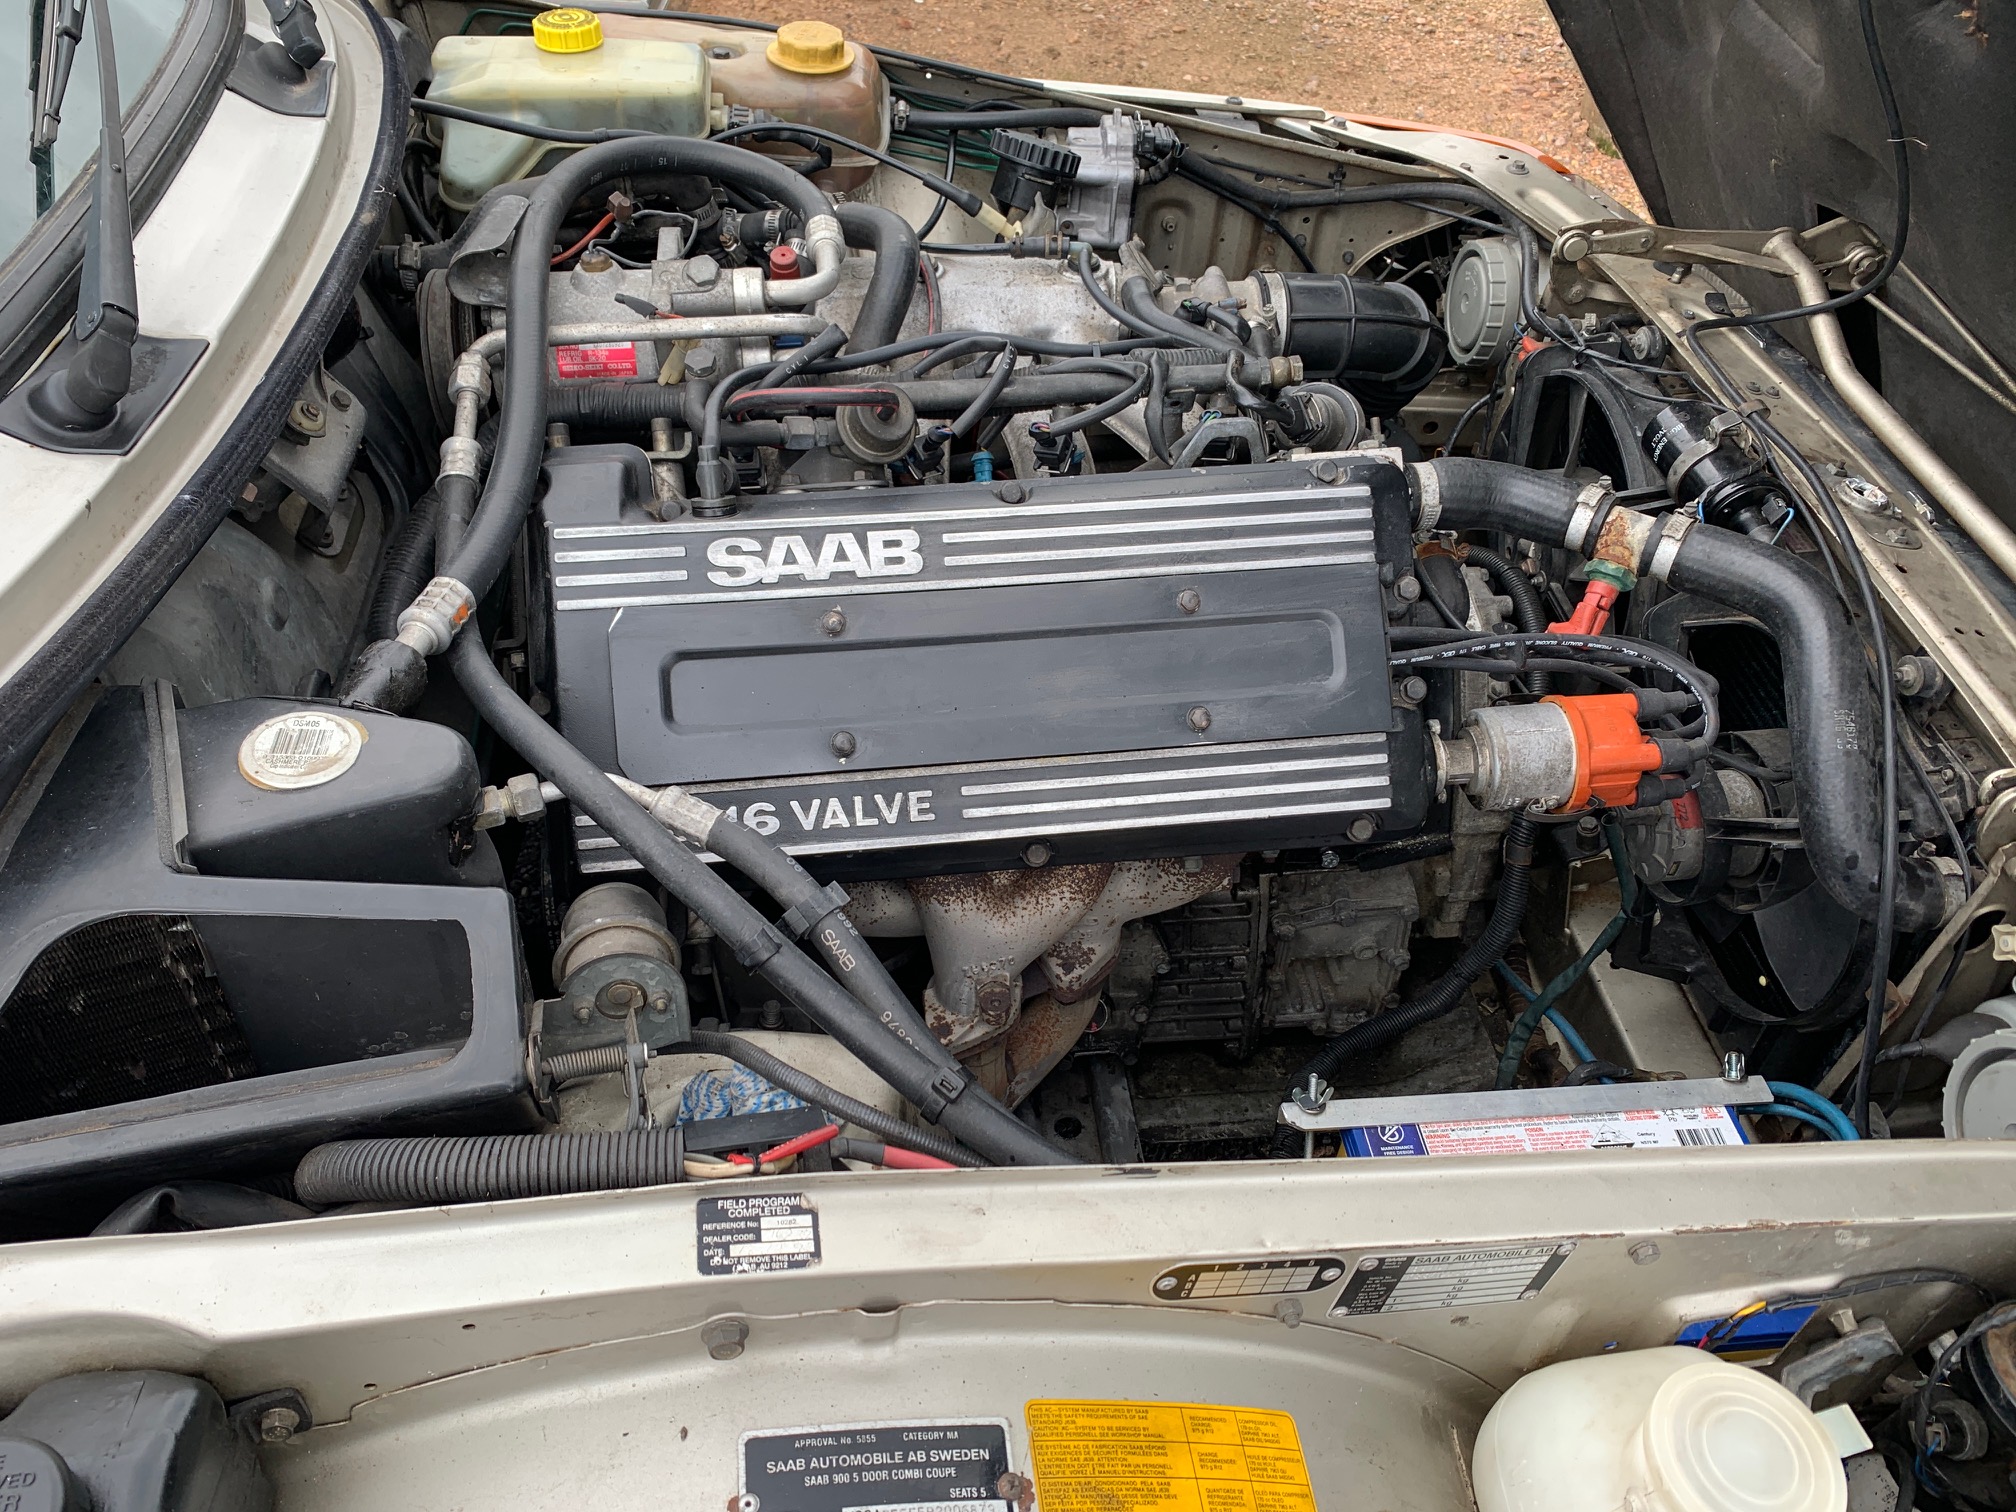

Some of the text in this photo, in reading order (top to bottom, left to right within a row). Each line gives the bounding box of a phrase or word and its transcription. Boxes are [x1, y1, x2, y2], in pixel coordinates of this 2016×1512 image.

[706, 528, 924, 587] SAAB
[790, 790, 936, 831] VALVE
[821, 929, 855, 972] SAAB
[718, 1196, 800, 1210] FIELD PROGRAM
[728, 1206, 790, 1218] COMPLETED
[703, 1221, 746, 1231] REFERENCE
[740, 1255, 771, 1264] REMOVE
[772, 1254, 788, 1262] THIS
[1453, 1250, 1533, 1261] AUTOMOBILE
[794, 1437, 837, 1448] APPROVAL
[903, 1432, 944, 1441] CATEGORY
[947, 1431, 959, 1439] MA
[767, 1449, 990, 1473] SAAB AUTOMOBILE AB SWEDEN
[804, 1467, 956, 1486] SAAB 900 5 DOOR COMBI COUPE
[950, 1487, 987, 1498] SEATS 5
